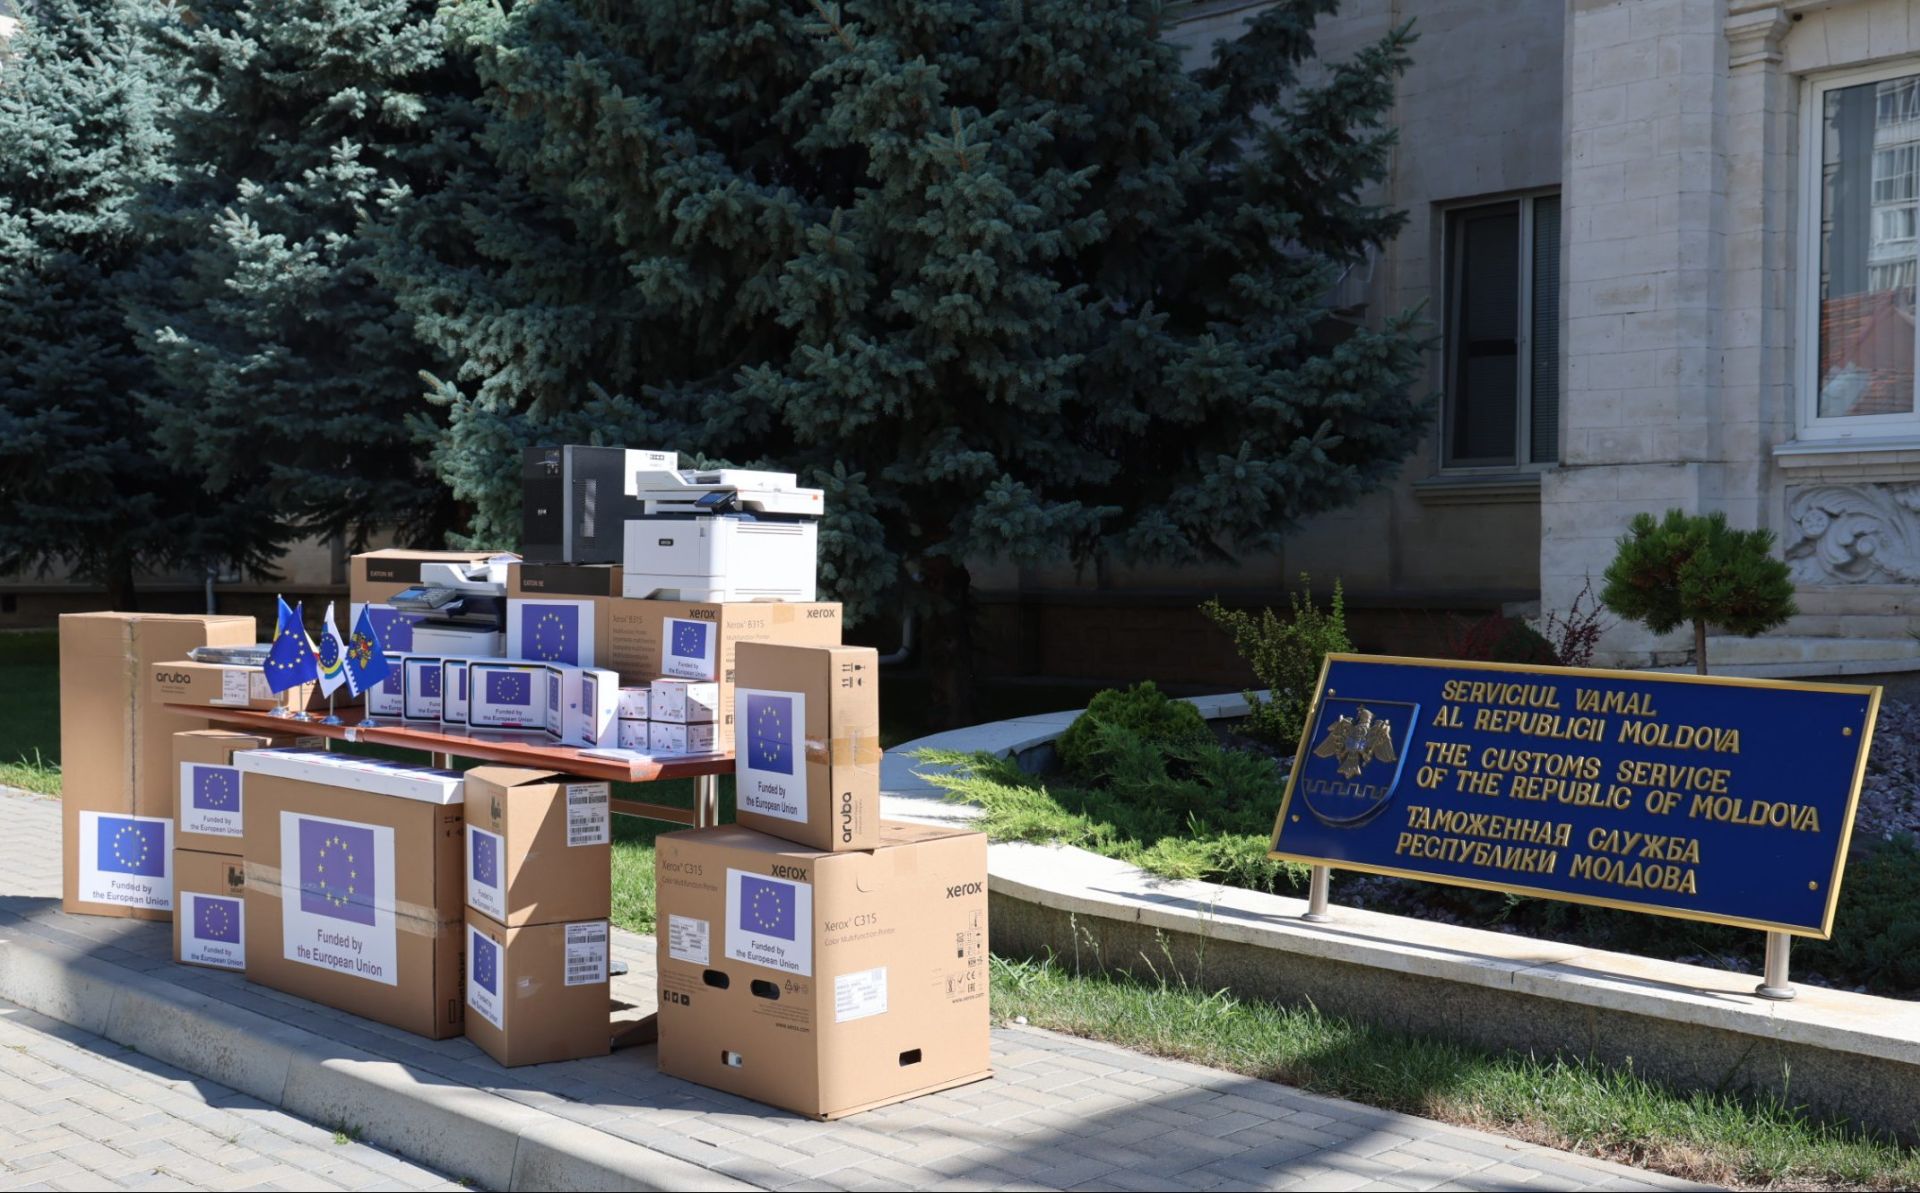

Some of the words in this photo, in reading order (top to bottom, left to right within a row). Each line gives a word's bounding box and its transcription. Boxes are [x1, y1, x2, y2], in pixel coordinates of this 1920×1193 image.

[689, 608, 715, 619] xerox
[806, 608, 835, 618] xerox
[747, 620, 765, 629] B315
[156, 672, 191, 684] aruba
[1441, 680, 1560, 709] SERVICIUL
[1575, 688, 1657, 717] VAMAL
[1432, 707, 1464, 729] AL
[1474, 709, 1605, 743] REPUBLICII
[1619, 720, 1741, 754] MOLDOVA
[1425, 741, 1471, 767] THE
[1481, 747, 1602, 781] CUSTOMS
[1616, 760, 1731, 794] SERVICE
[758, 782, 778, 795] Funded
[779, 787, 786, 798] by
[746, 796, 755, 806] the
[755, 797, 781, 812] European
[781, 803, 798, 815] Union
[1416, 766, 1447, 790] OF
[1455, 770, 1500, 796] THE
[1509, 774, 1631, 810] REPUBLIC
[1645, 791, 1681, 815] OF
[1690, 795, 1820, 833] MOLDOVA
[203, 815, 223, 824] Funded
[224, 817, 232, 825] by
[840, 792, 852, 843] aruba
[200, 824, 225, 833] European
[1406, 805, 1571, 848] ТАМОЖЕННАЯ
[1587, 827, 1700, 864] СЛУЖБА
[1396, 832, 1558, 875] РЕСПУБЛИКИ
[1569, 855, 1697, 894] МОЛДОВА
[772, 864, 807, 880] xerox
[111, 881, 142, 892] Funded
[142, 885, 152, 894] by
[946, 881, 982, 899] xerox
[107, 892, 144, 904] European
[145, 896, 169, 906] Union
[854, 913, 877, 927] C315
[318, 929, 350, 948] Funded
[352, 937, 363, 954] by
[751, 940, 775, 954] Funded
[777, 948, 785, 957] by
[204, 945, 223, 954] Funded
[224, 948, 232, 956] by
[200, 954, 226, 964] European
[227, 958, 243, 966] Union
[297, 945, 310, 959] the
[313, 948, 353, 969] European
[356, 959, 382, 977] Union
[736, 949, 746, 958] the
[747, 952, 778, 966] European
[780, 958, 799, 970] Union
